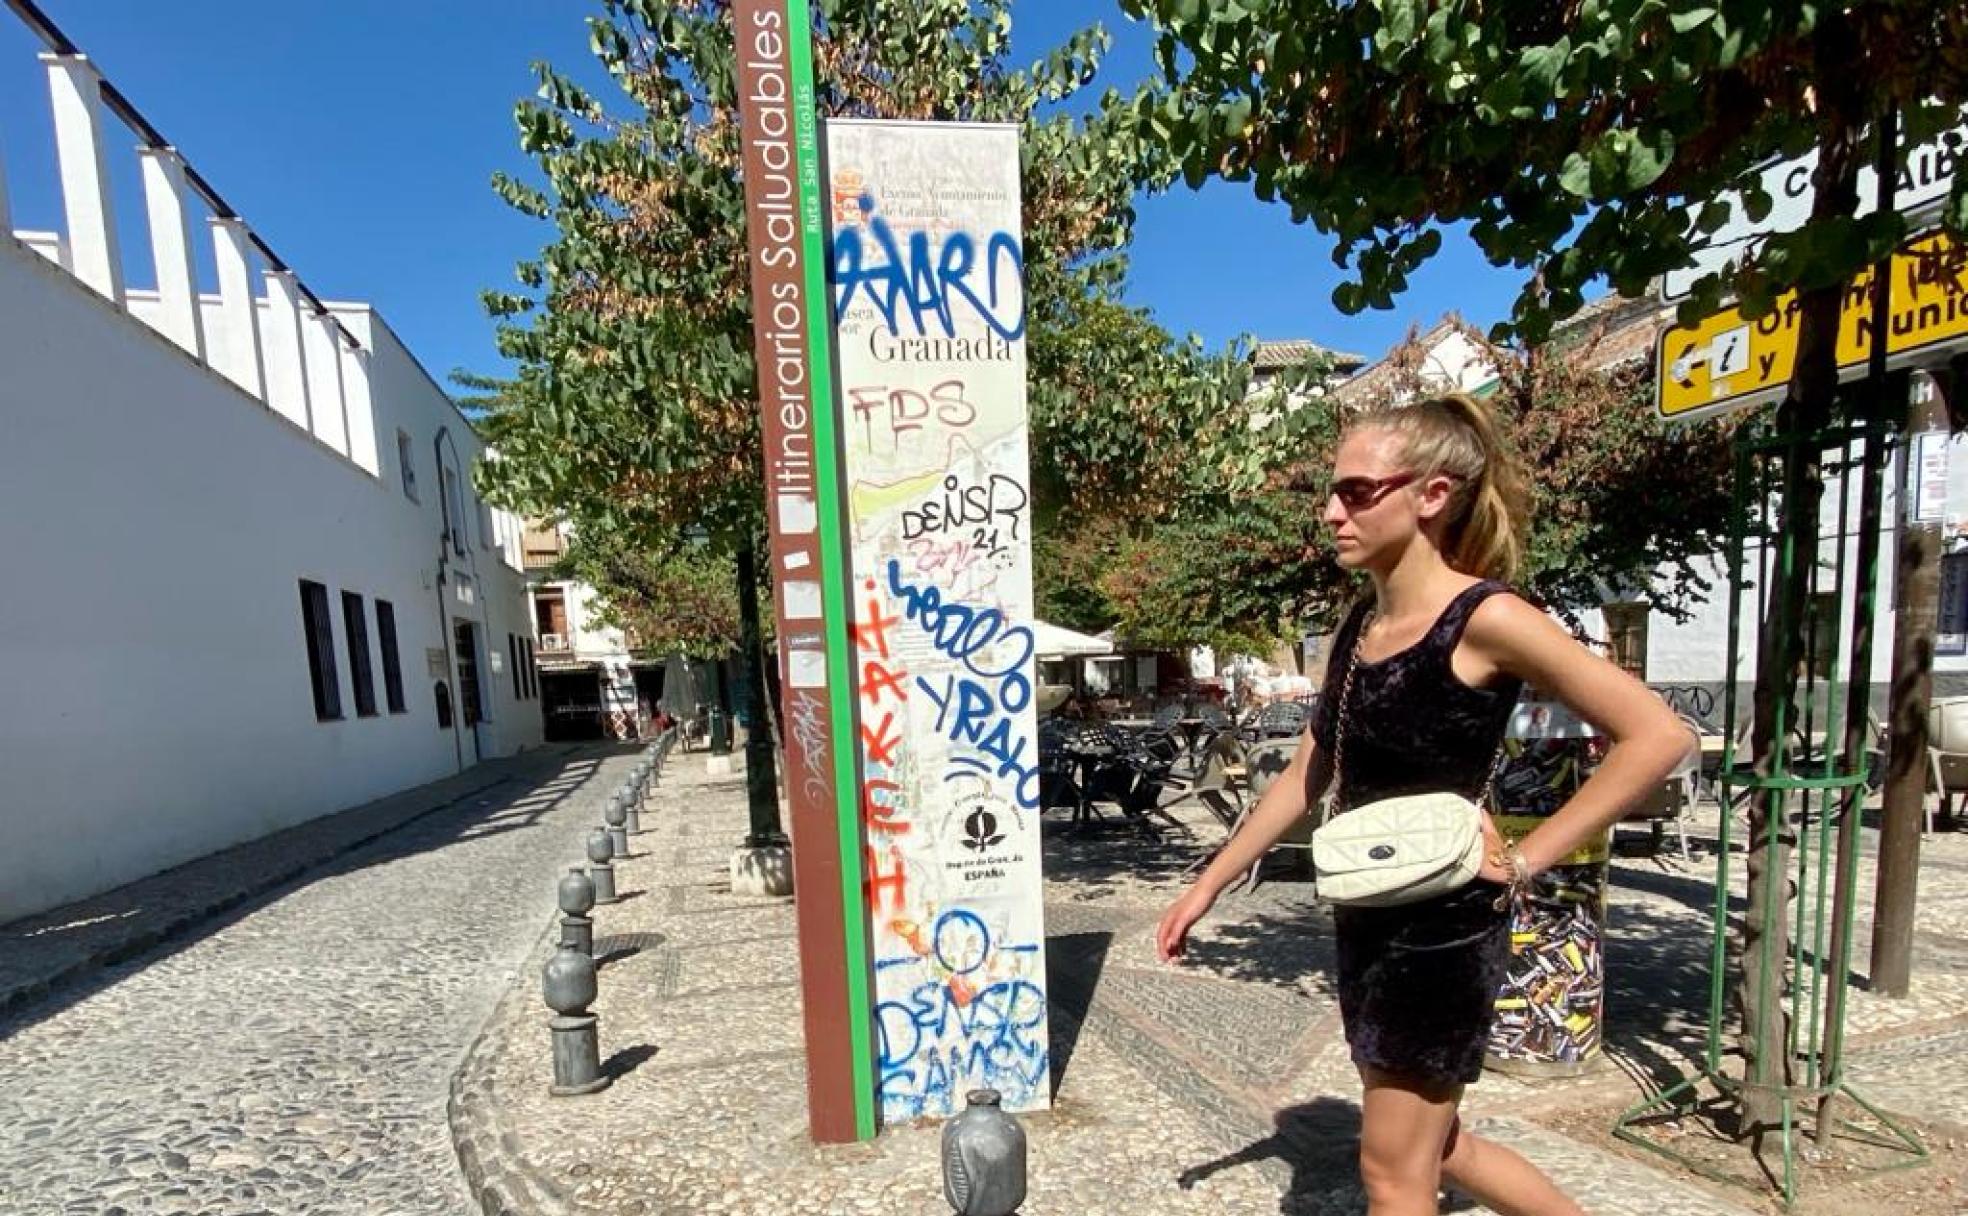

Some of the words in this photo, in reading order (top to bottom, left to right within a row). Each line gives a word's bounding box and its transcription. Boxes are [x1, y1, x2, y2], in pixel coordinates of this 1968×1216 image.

[748, 9, 797, 268] Saludables
[804, 159, 816, 186] San
[807, 196, 820, 233] Ruta
[870, 325, 1012, 362] Granada
[1758, 351, 1777, 382] y
[766, 282, 812, 493] Itinerarios
